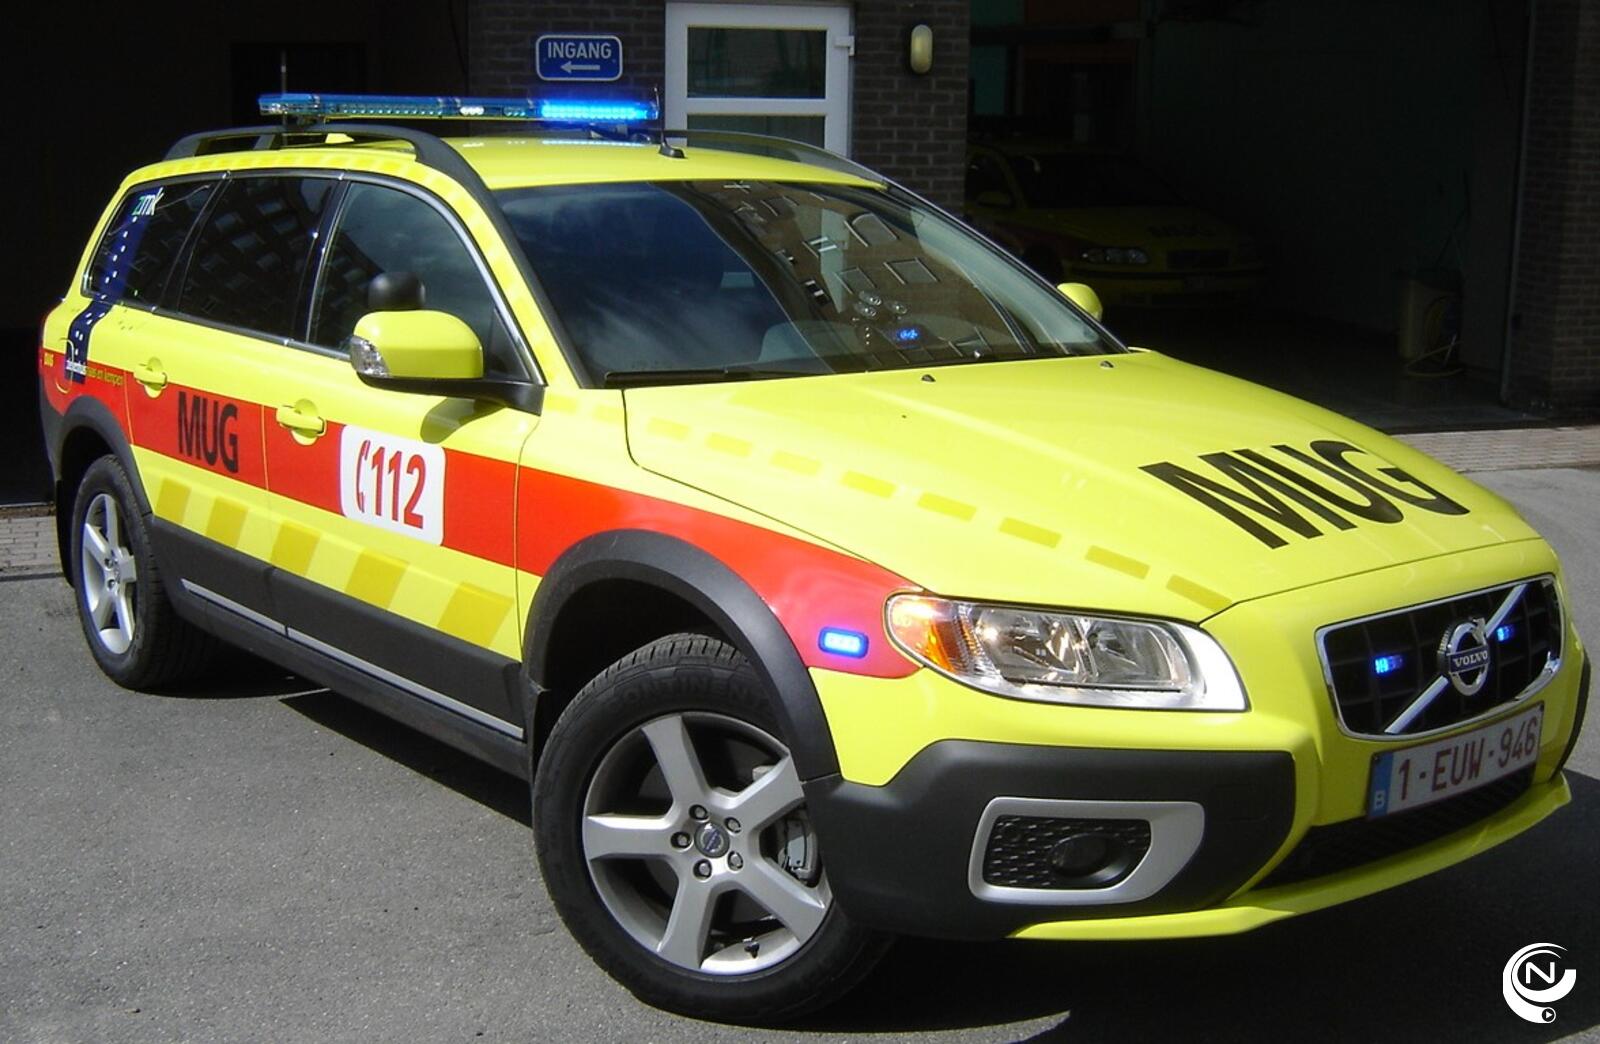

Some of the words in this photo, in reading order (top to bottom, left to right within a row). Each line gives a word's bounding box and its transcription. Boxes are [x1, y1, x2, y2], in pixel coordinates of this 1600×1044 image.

[547, 41, 612, 59] INGANG
[177, 390, 239, 473] MUG
[1137, 439, 1471, 549] MUG
[1452, 650, 1488, 668] VOLVO
[1398, 716, 1538, 801] 1-EUW-946
